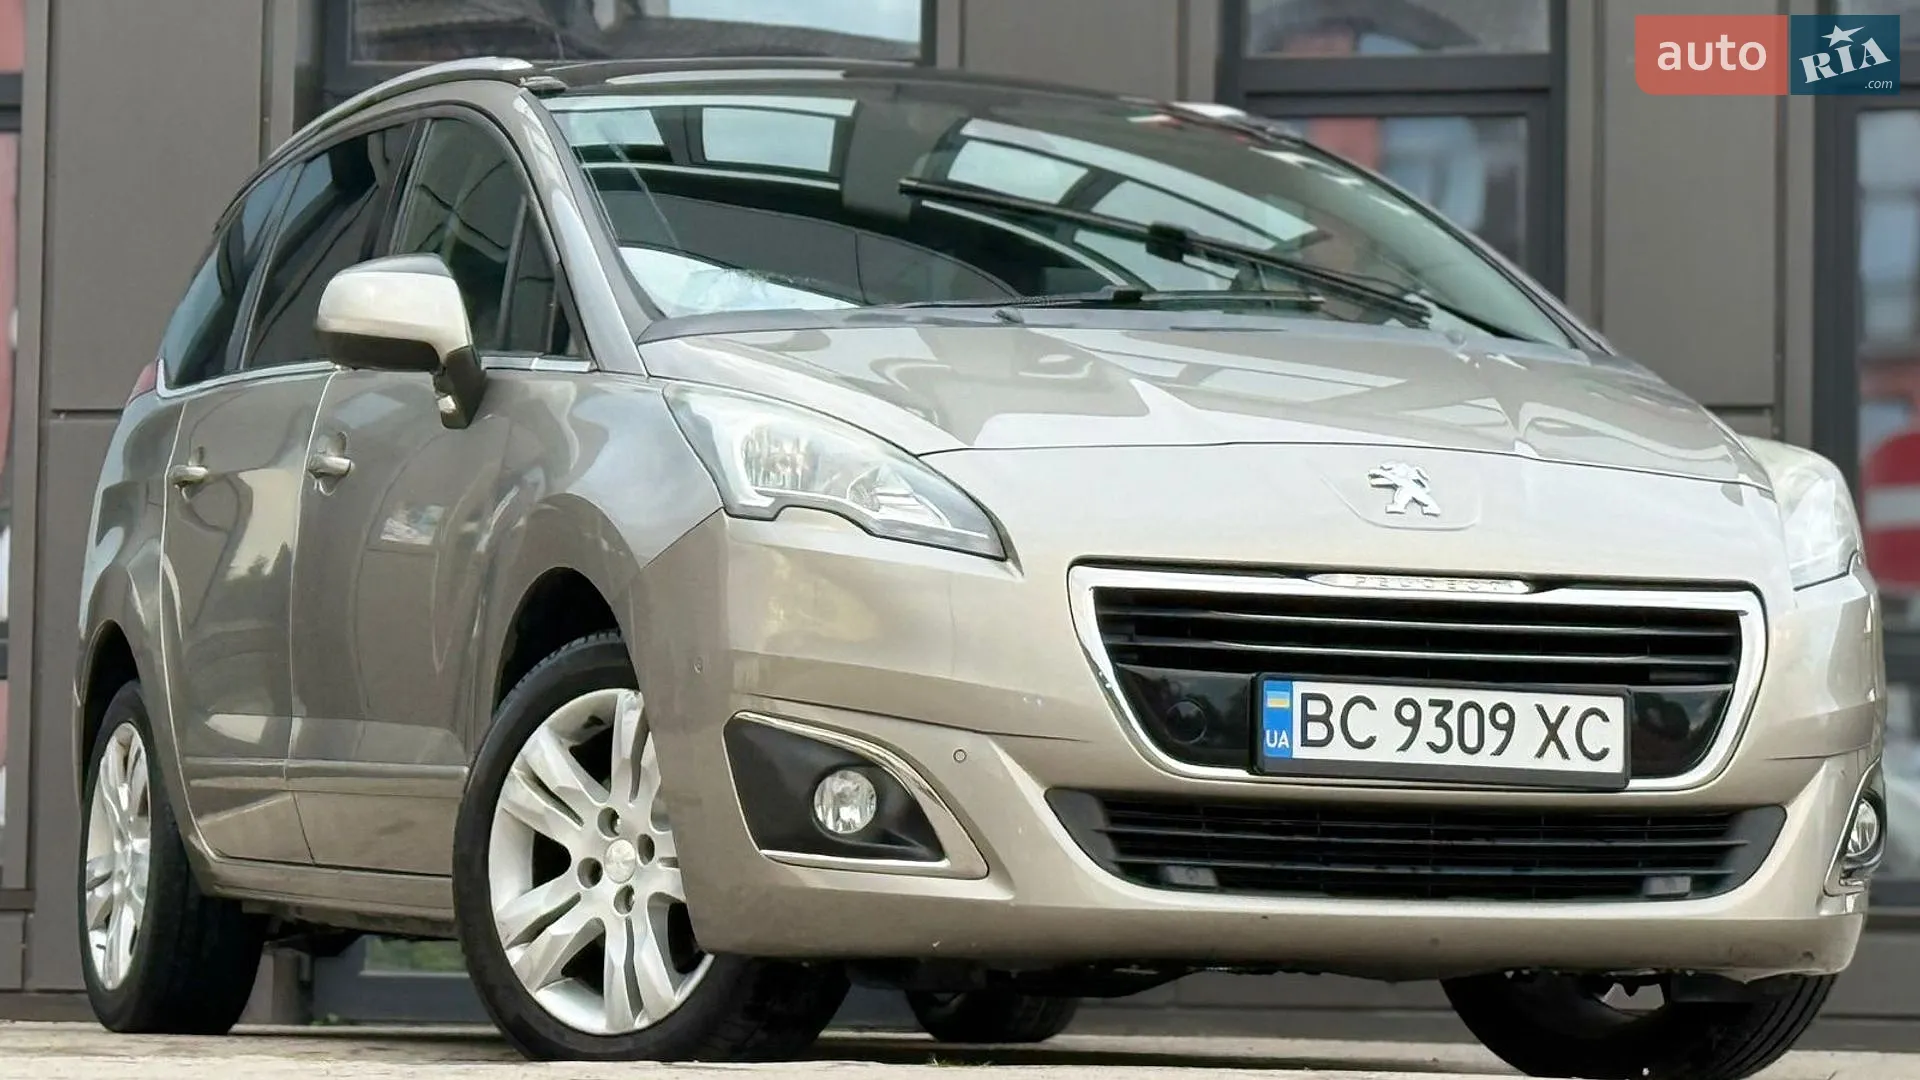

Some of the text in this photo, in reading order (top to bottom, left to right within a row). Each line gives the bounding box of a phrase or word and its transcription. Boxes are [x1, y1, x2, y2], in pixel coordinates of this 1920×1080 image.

[1265, 730, 1290, 749] UA
[1300, 692, 1610, 762] BC 9309 XC
